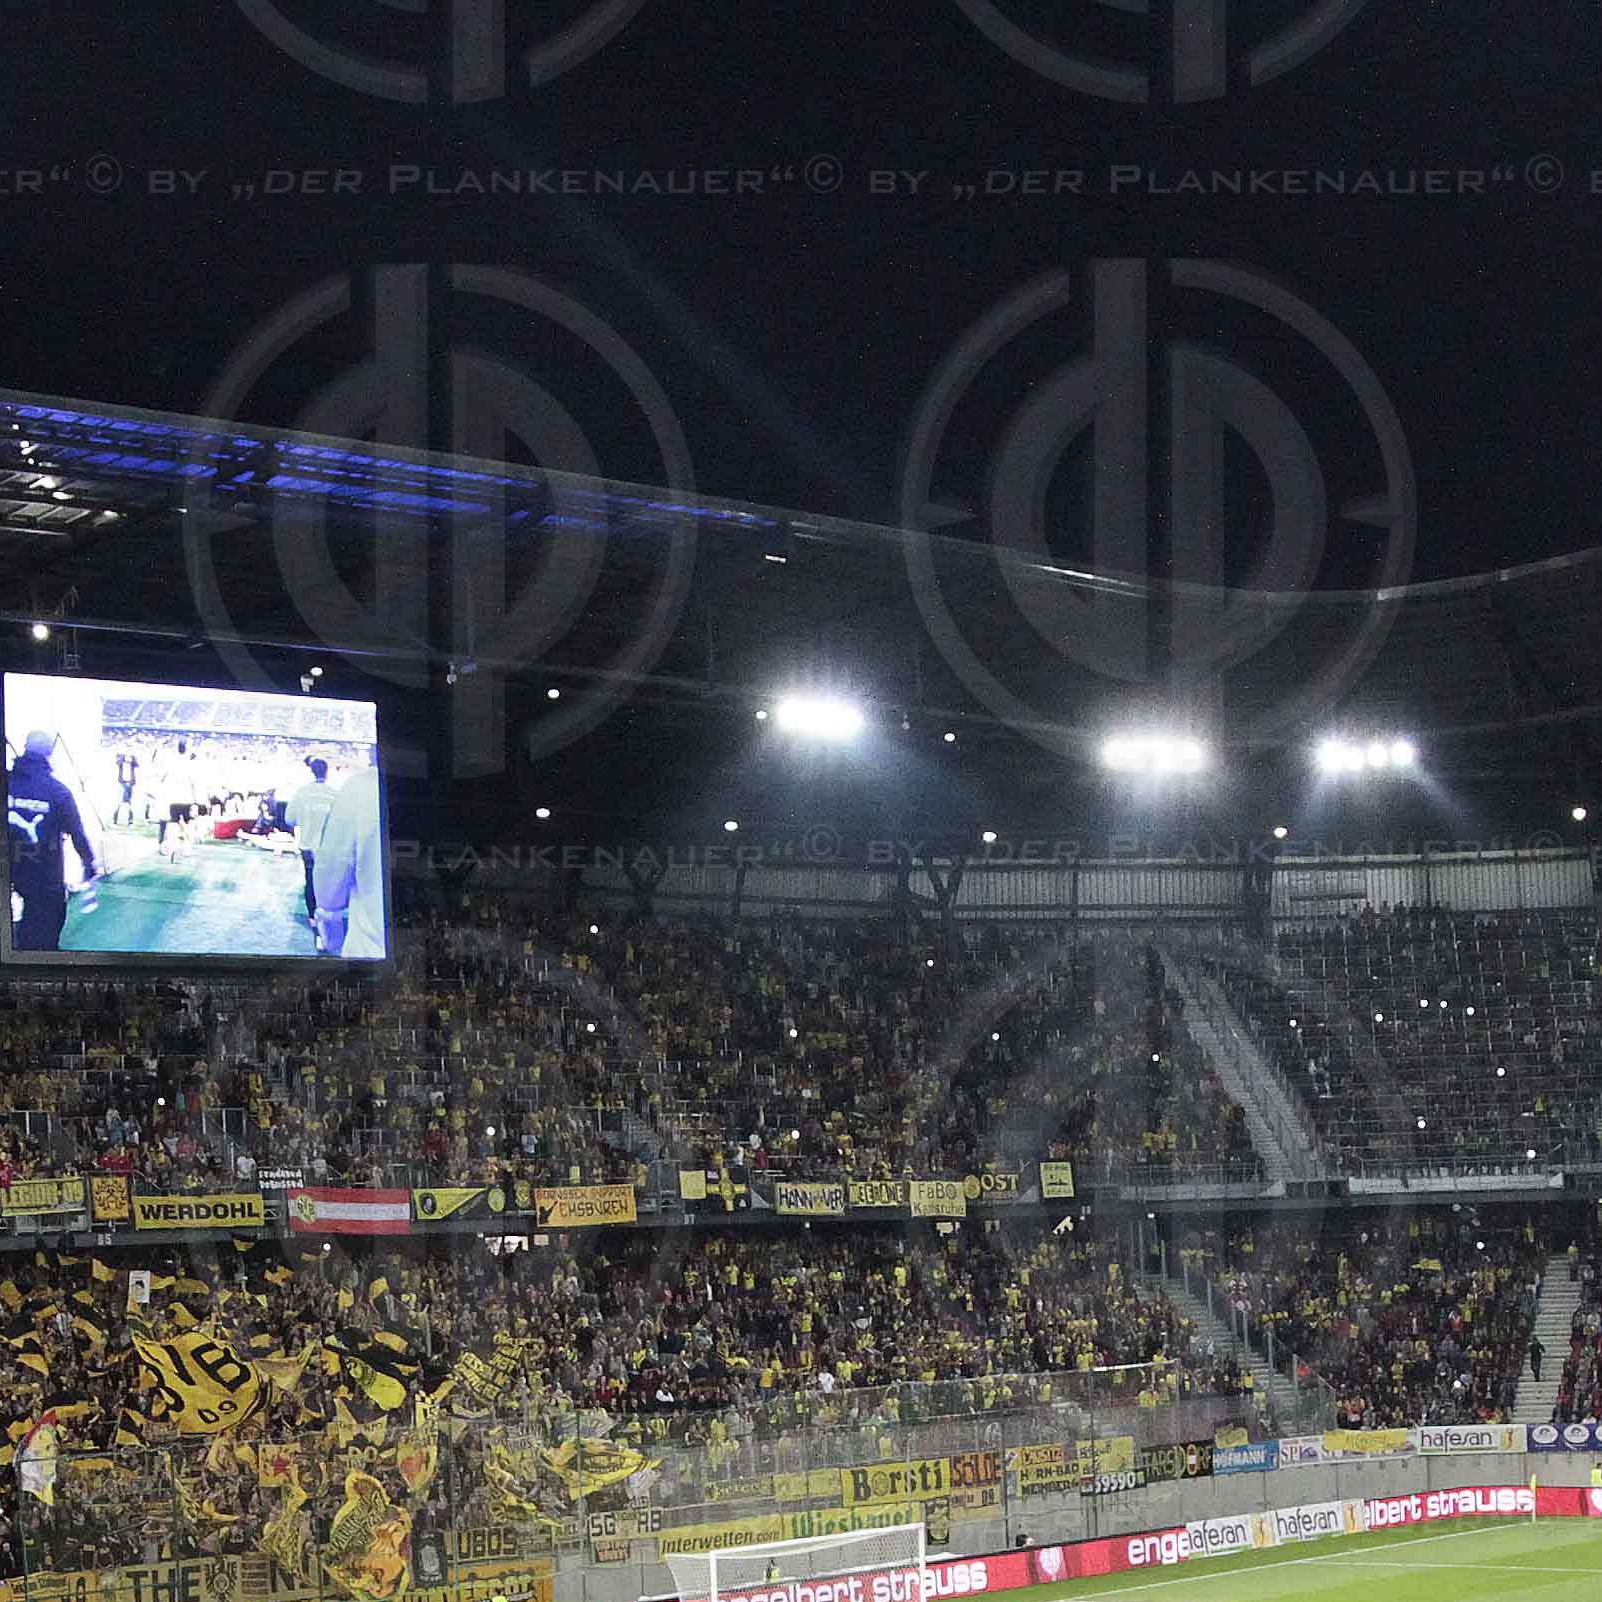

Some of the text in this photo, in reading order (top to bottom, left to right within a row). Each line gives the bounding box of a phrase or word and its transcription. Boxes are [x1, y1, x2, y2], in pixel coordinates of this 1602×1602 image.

[140, 1203, 260, 1221] WERDOHL
[1420, 1429, 1492, 1449] hafesan
[1427, 1488, 1535, 1518] strauss
[1275, 1508, 1339, 1541] hafesan
